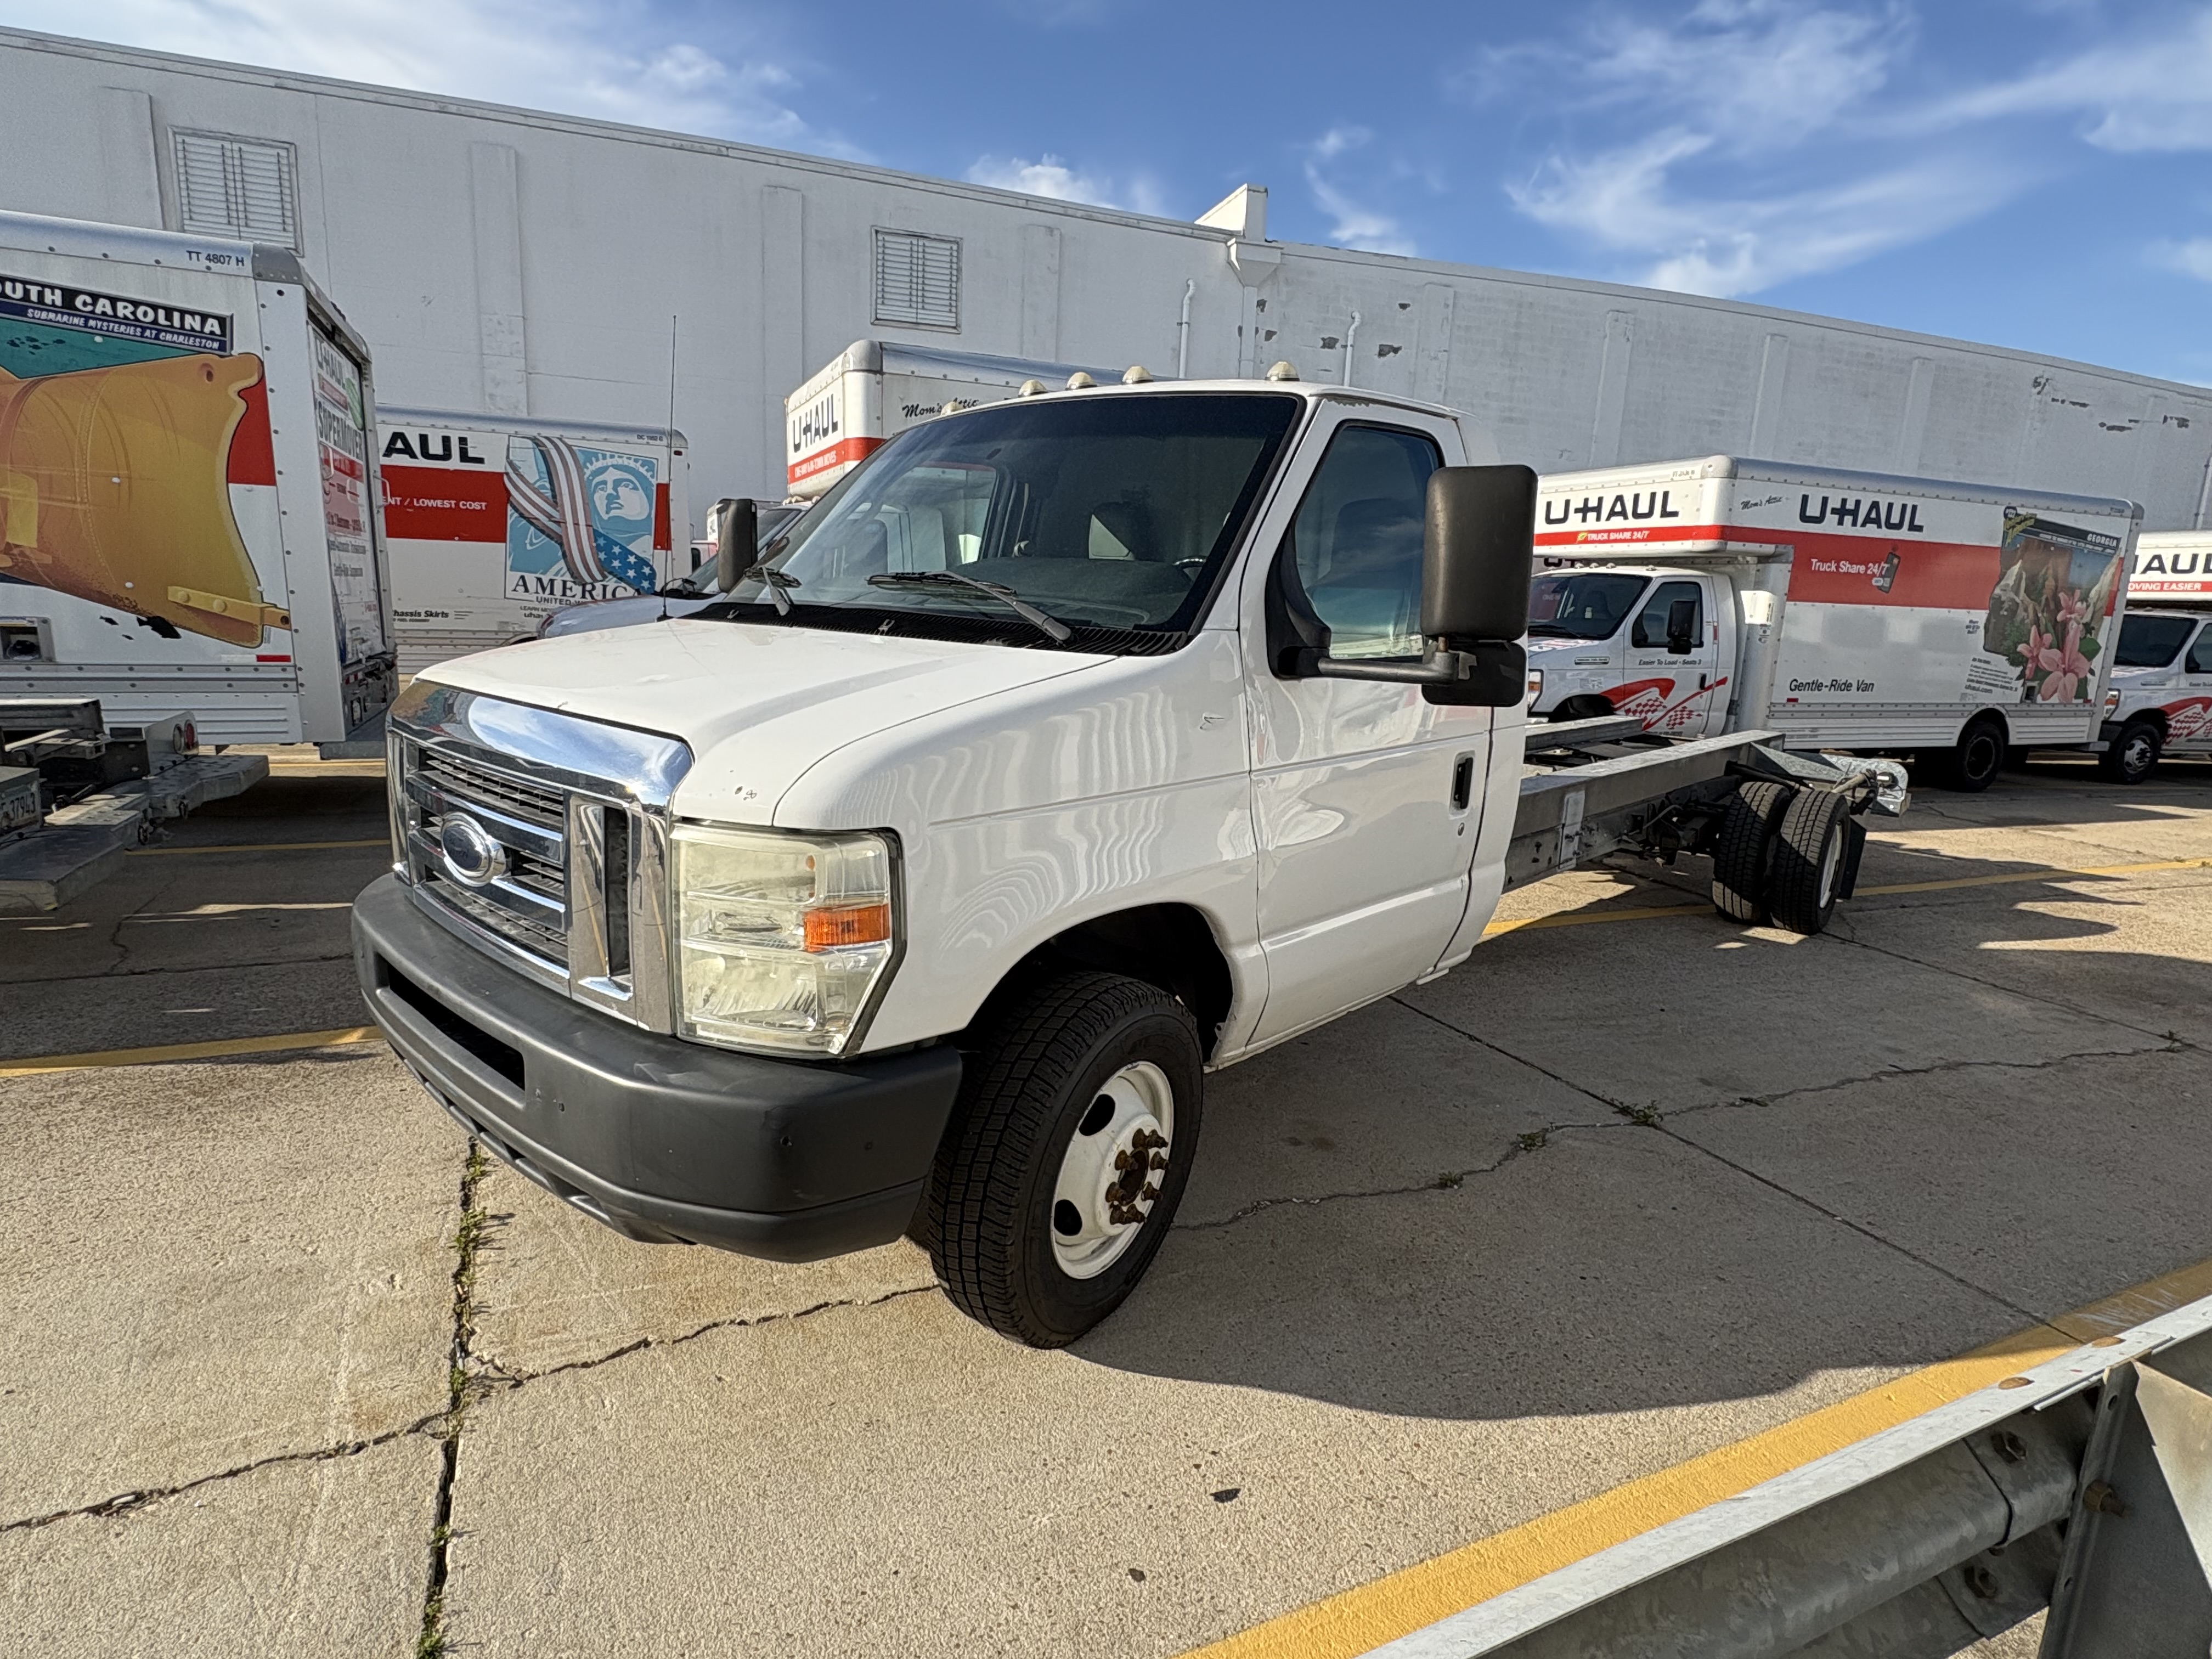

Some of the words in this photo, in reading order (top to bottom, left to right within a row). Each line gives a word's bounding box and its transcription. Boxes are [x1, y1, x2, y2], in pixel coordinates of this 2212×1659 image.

[186, 250, 201, 262] TT
[205, 253, 232, 265] 4807
[235, 256, 244, 266] H
[0, 281, 63, 307] UTH
[75, 294, 221, 335] CAROLINA
[27, 308, 85, 326] SUBMARINE
[88, 319, 142, 336] MYSTERIES
[144, 329, 157, 338] AT
[159, 332, 219, 349] CHARLESTON
[793, 393, 838, 453] U-HAUL
[414, 498, 456, 509] LOWEST
[459, 501, 487, 510] COST
[1545, 490, 1679, 525] U-HAUL
[1799, 494, 1924, 533] U-HAUL
[1587, 533, 1609, 541] TRUCK
[1609, 531, 1632, 540] SHARE
[1632, 530, 1650, 539] 24/7
[2087, 533, 2118, 548] GEORGIA
[1811, 558, 1837, 572] Truck
[1839, 561, 1865, 574] Share
[1867, 561, 1890, 577] 24/7
[2163, 582, 2202, 591] EASIER
[536, 596, 572, 605] UNITED
[393, 609, 421, 618] hassis
[424, 610, 449, 618] Skirts
[1790, 678, 1853, 692] Gentle-Ride
[1856, 679, 1875, 692] Van
